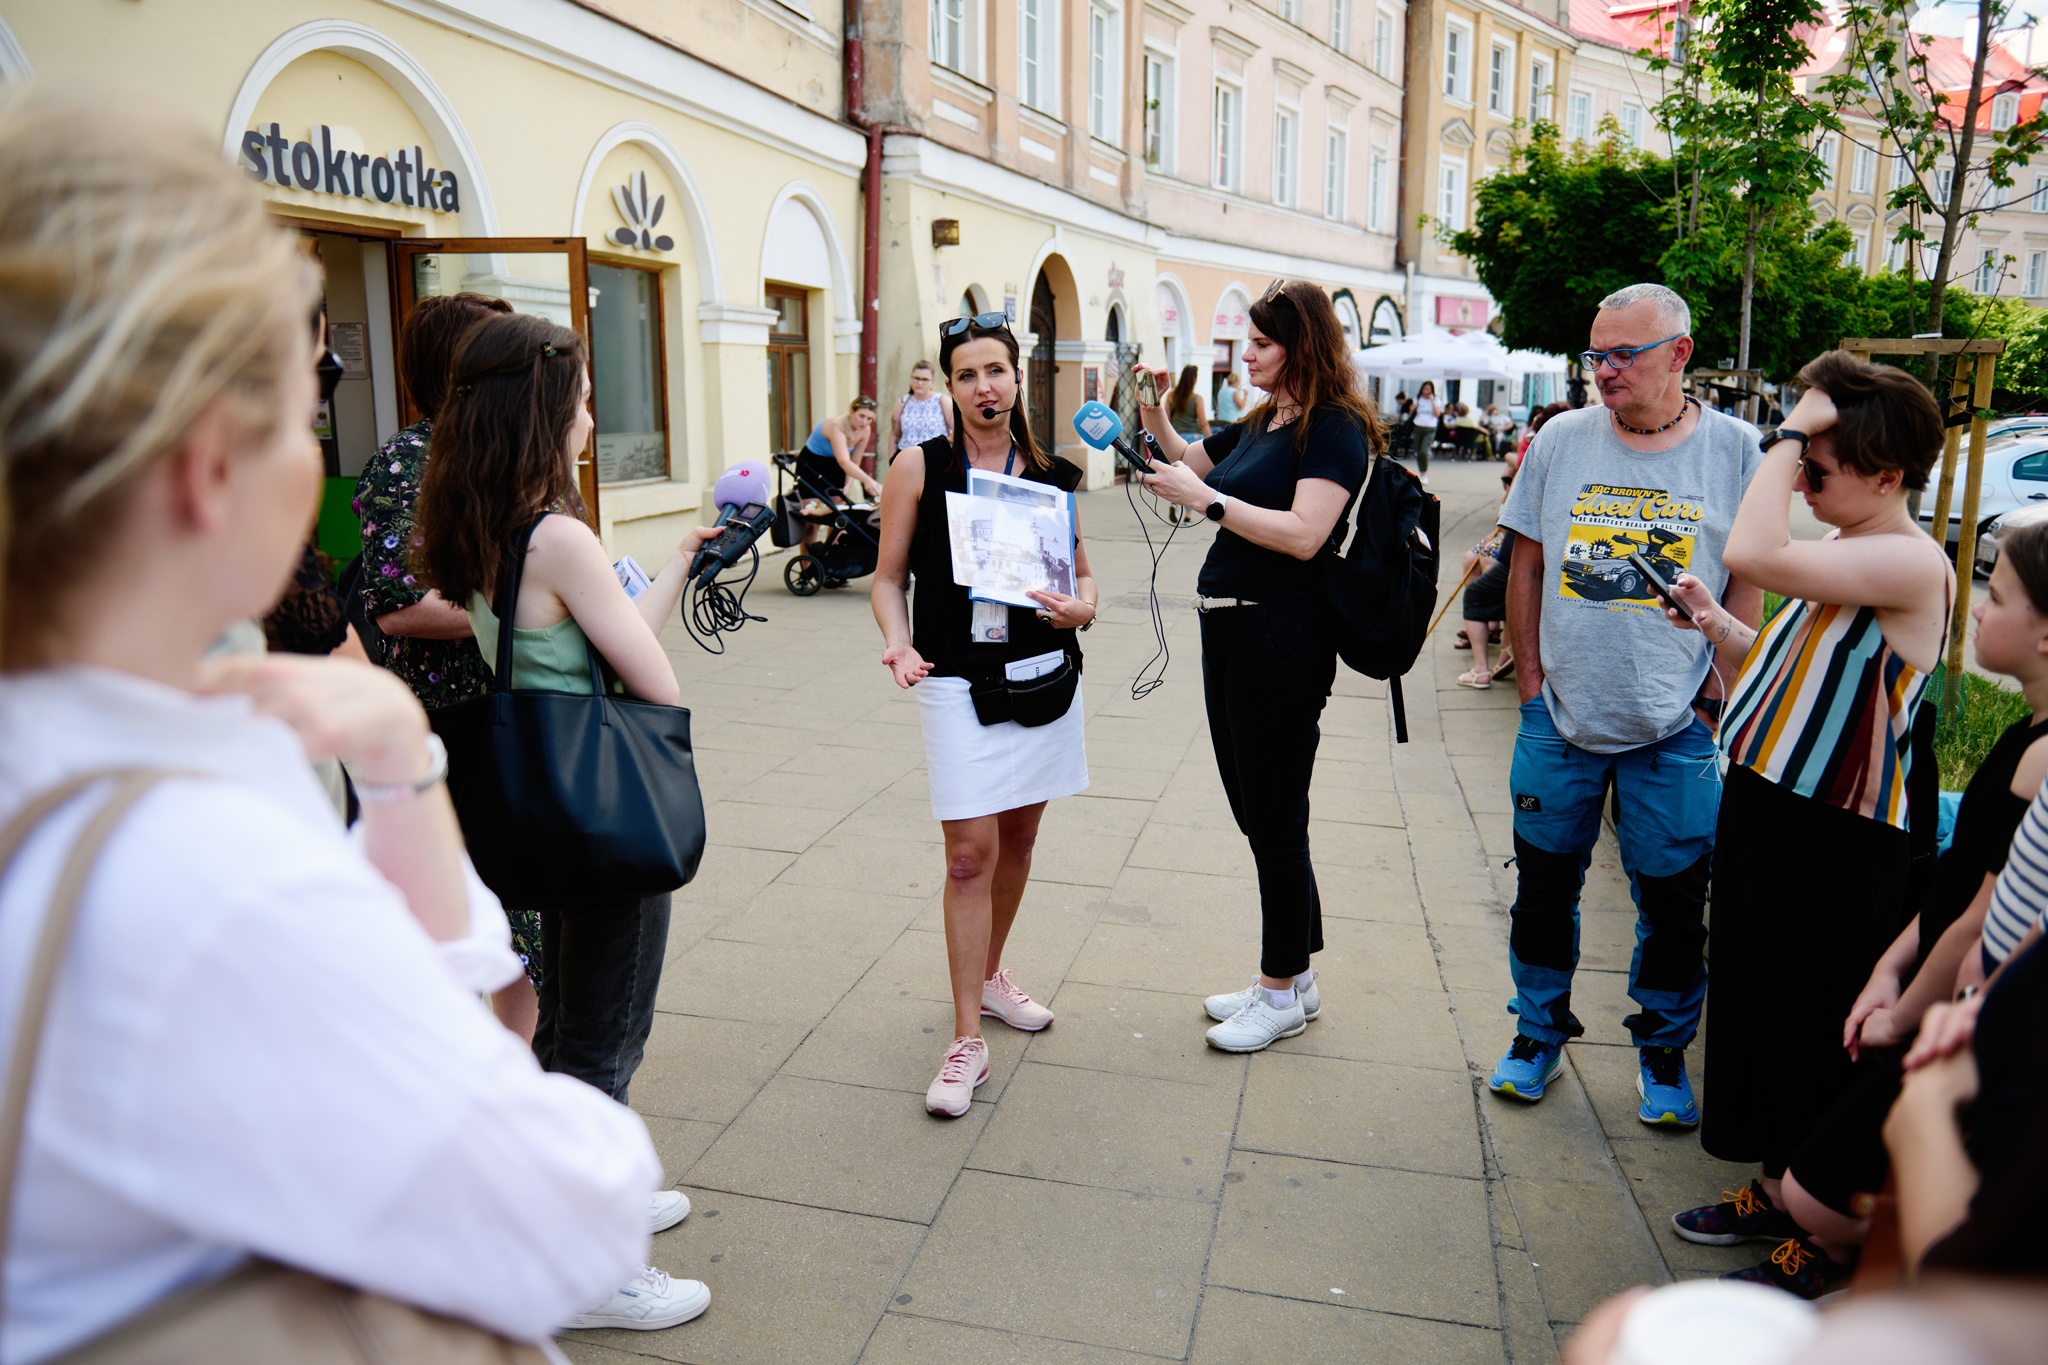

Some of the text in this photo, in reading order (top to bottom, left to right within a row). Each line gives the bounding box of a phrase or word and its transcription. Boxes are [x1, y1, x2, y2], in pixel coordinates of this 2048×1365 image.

[240, 122, 460, 213] stokrotka
[1570, 489, 1705, 521] Used Cars
[1589, 517, 1623, 526] GREATEST
[1676, 525, 1696, 533] TIME!
